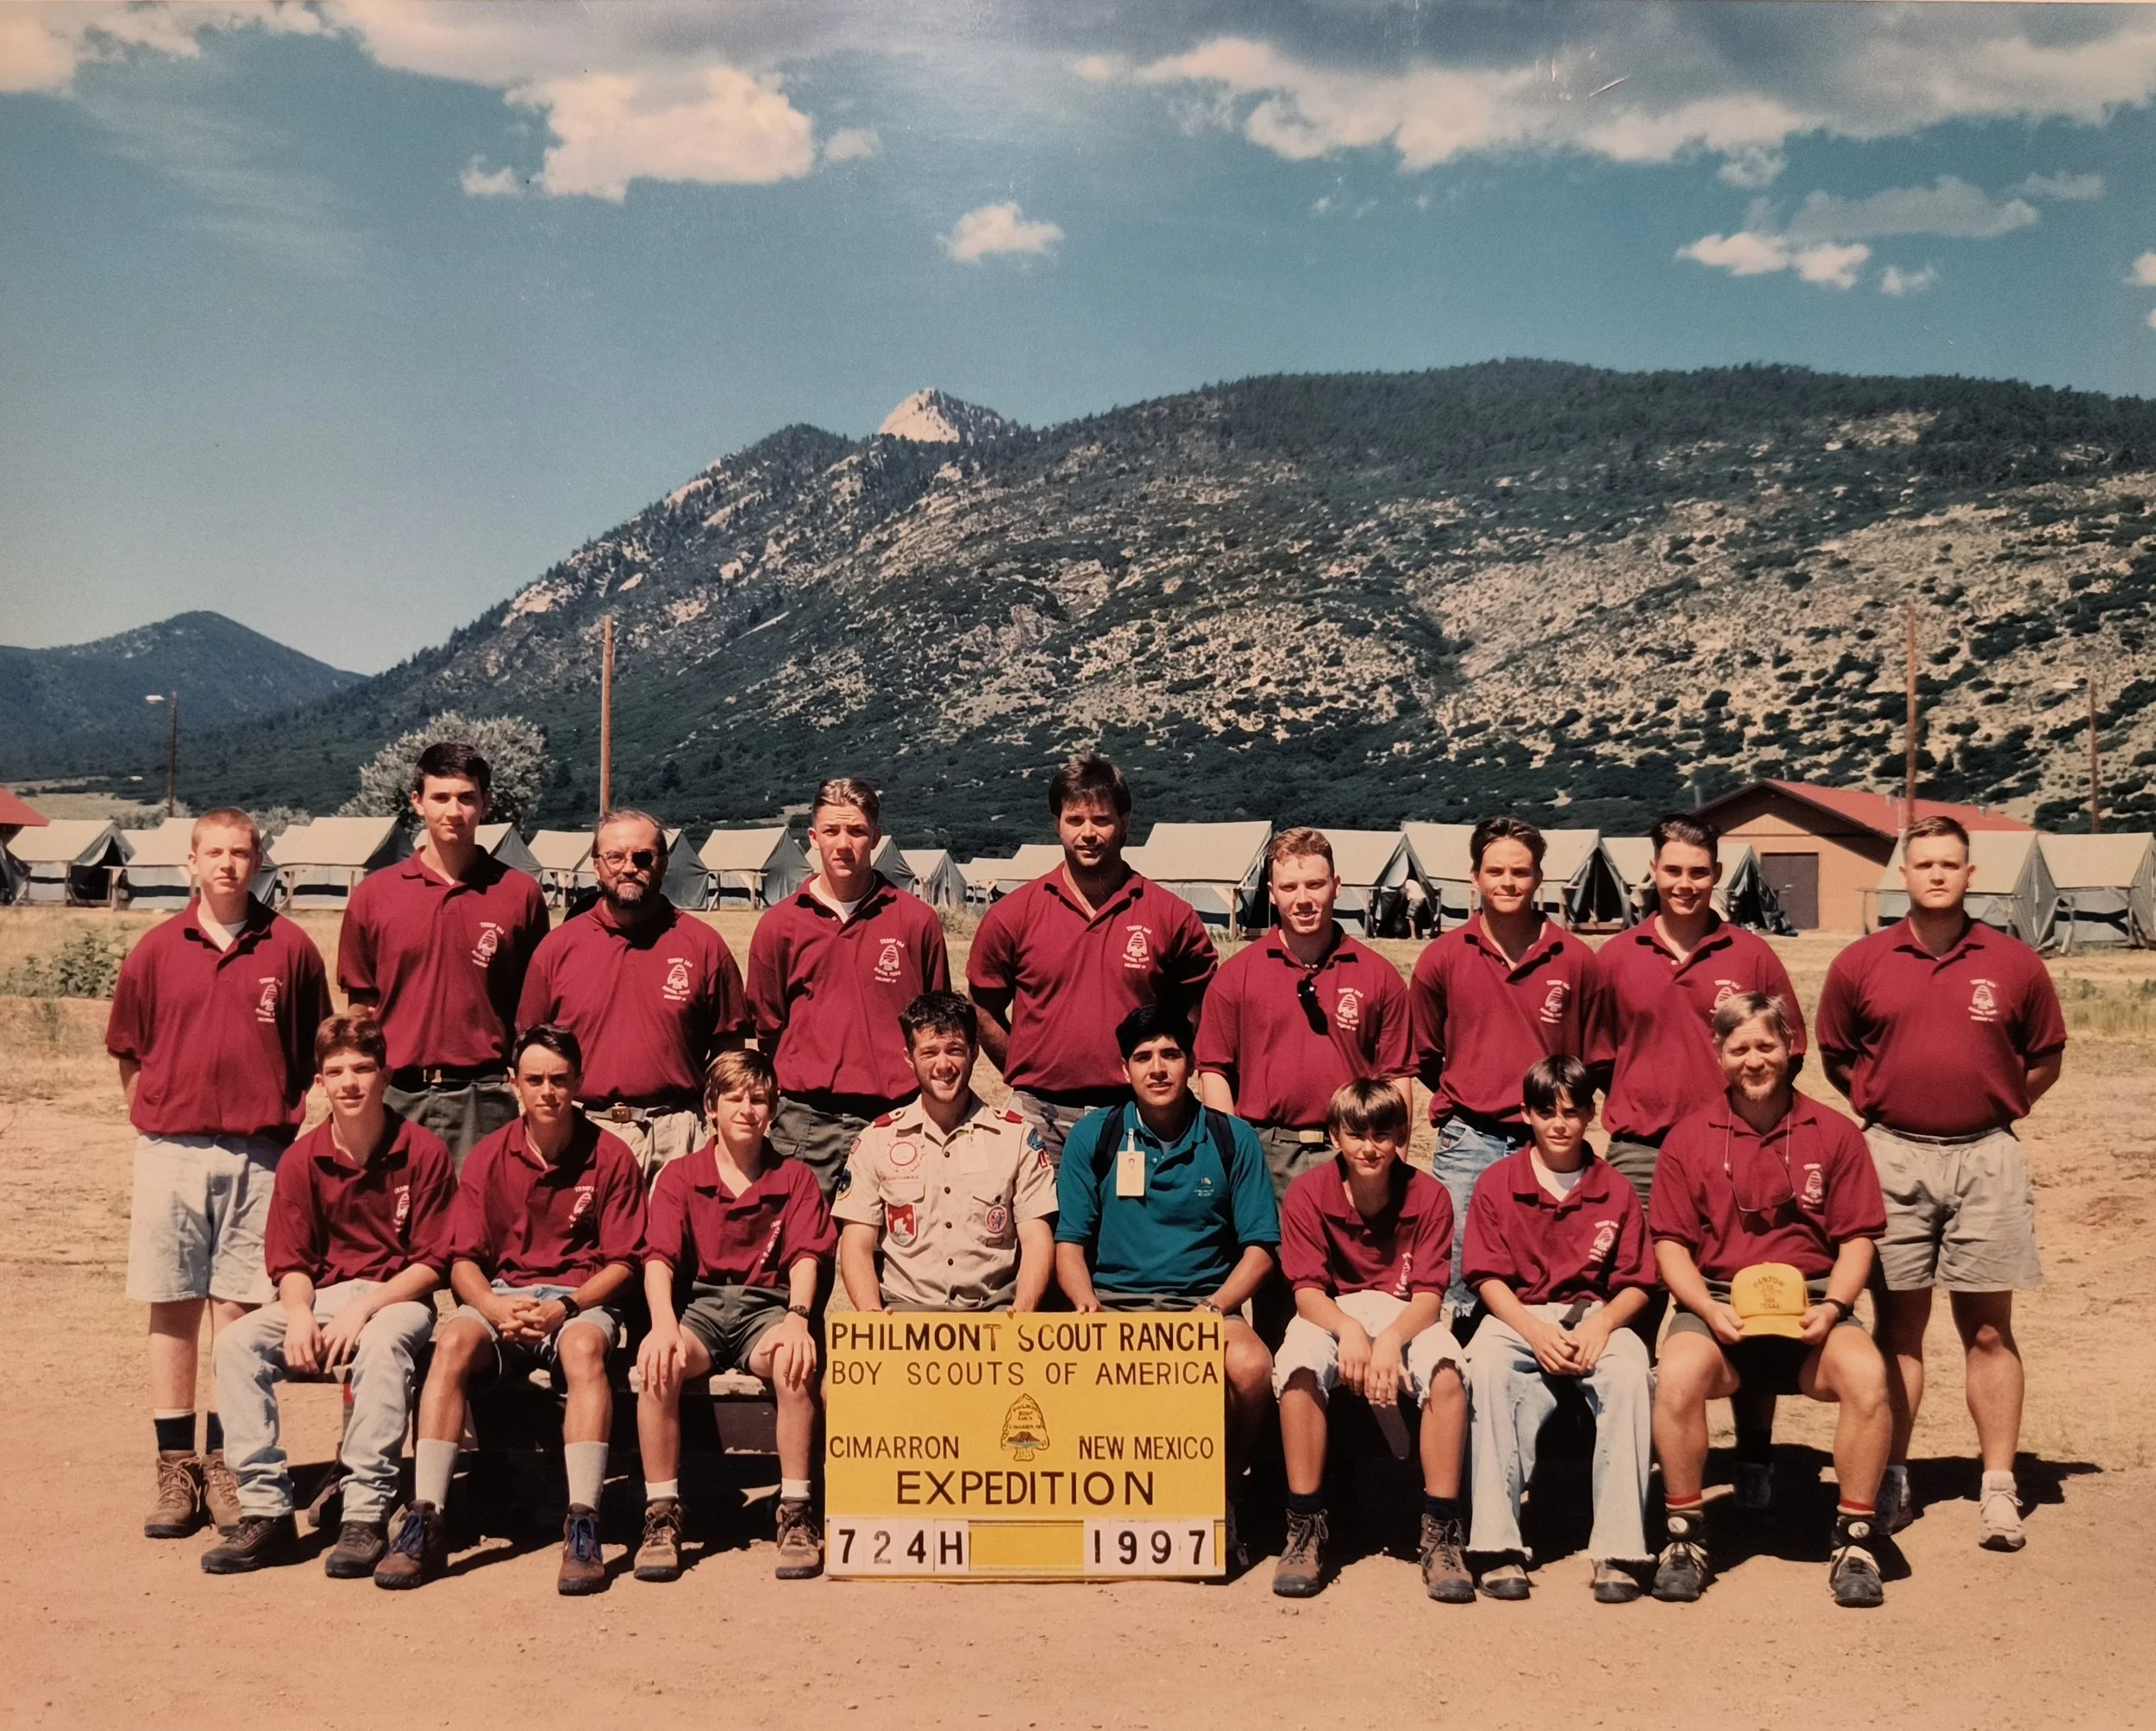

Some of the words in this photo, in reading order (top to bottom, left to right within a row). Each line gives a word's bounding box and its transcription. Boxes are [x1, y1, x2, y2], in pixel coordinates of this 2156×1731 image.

[1752, 1276, 1784, 1289] DENTON
[831, 1322, 1001, 1352] PHILMONT
[1018, 1322, 1107, 1352] SCOUT
[1119, 1322, 1219, 1352] RANCH
[831, 1360, 882, 1386] BOY
[906, 1361, 1025, 1386] SCOUTS
[1045, 1362, 1078, 1385] OF
[1095, 1361, 1219, 1386] AMERICA
[829, 1435, 959, 1459] CIMARRON
[1079, 1435, 1125, 1460] NEW
[1134, 1436, 1214, 1460] MEXICO
[897, 1471, 1154, 1506] EXPEDITION
[1094, 1529, 1206, 1565] 1997
